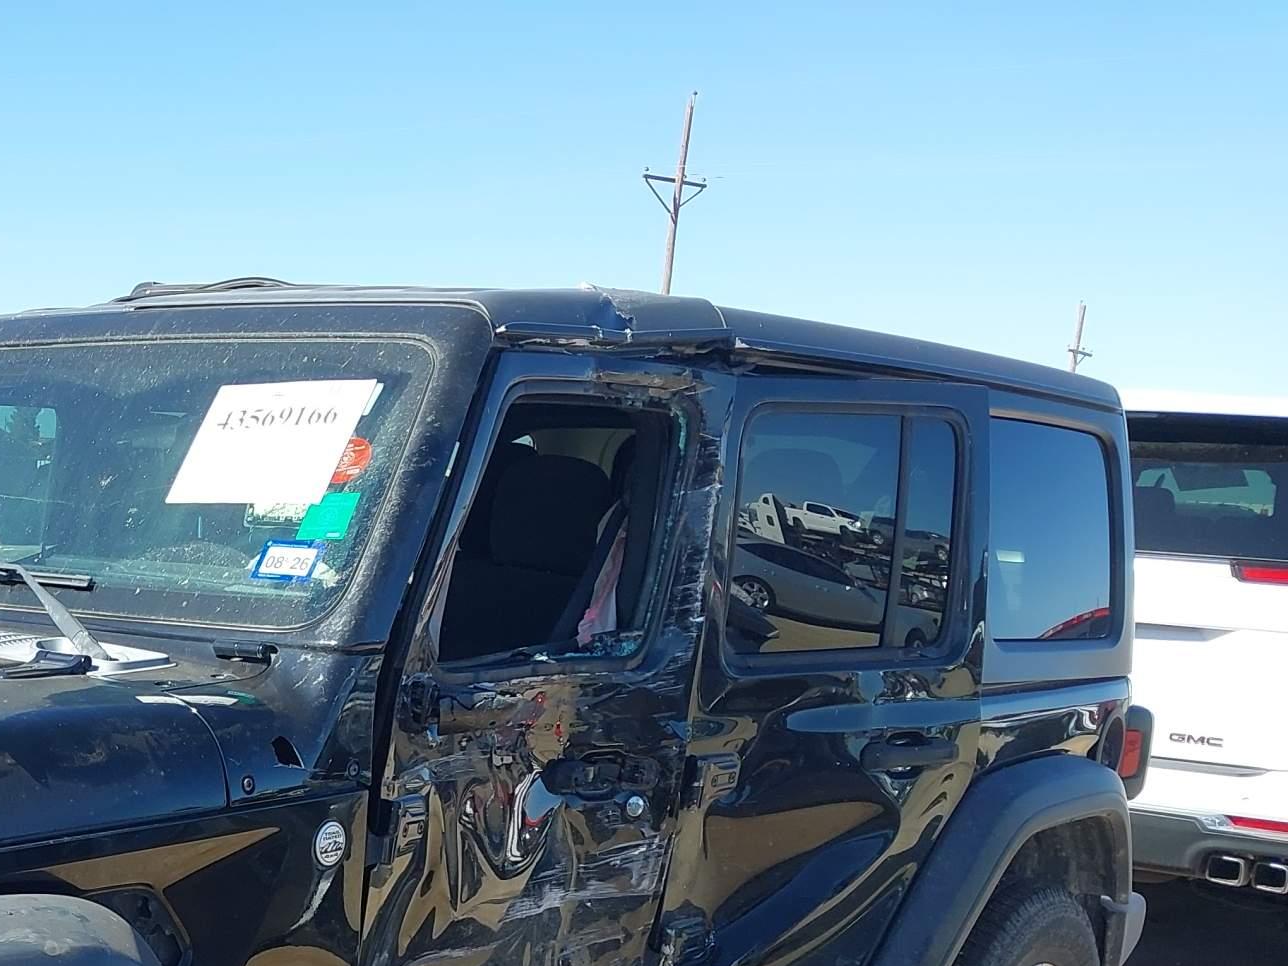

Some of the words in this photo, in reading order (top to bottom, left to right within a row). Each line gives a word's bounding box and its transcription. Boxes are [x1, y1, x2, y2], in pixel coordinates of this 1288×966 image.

[217, 406, 338, 431] 43569166
[290, 557, 311, 571] 26
[1169, 733, 1223, 748] GMC
